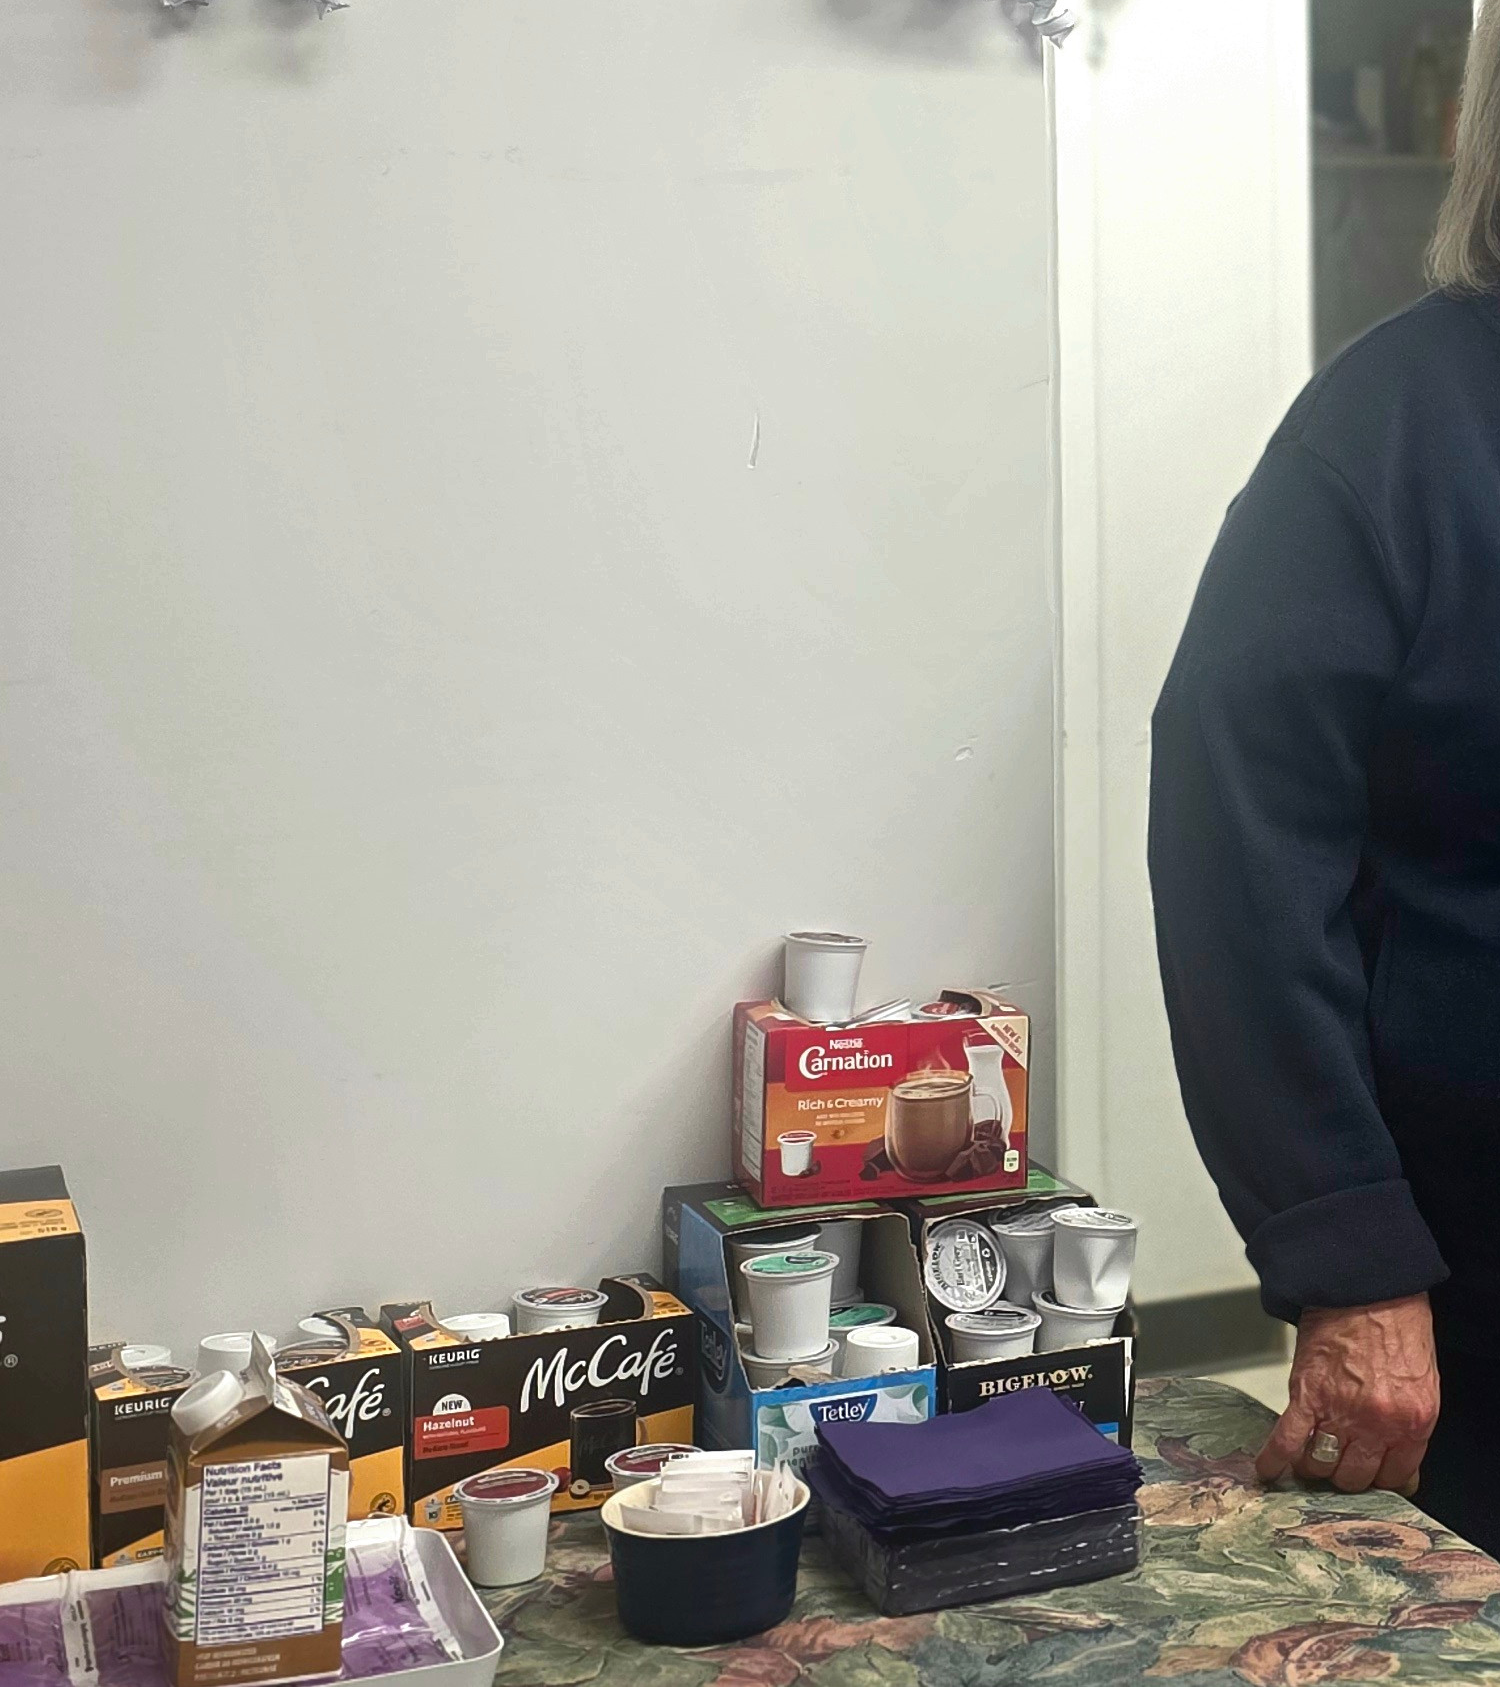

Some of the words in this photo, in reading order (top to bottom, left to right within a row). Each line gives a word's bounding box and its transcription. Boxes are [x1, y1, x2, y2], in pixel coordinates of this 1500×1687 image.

[799, 1046, 892, 1079] Carnation
[798, 1099, 824, 1111] Rich
[835, 1096, 884, 1109] Creamy
[429, 1348, 482, 1365] KEURIG
[520, 1328, 678, 1413] McCafé
[114, 1397, 172, 1416] KEURIG
[304, 1368, 385, 1439] afé
[441, 1400, 463, 1411] NEW
[818, 1399, 869, 1422] Tetley
[423, 1416, 475, 1432] Hazelnut
[110, 1471, 163, 1487] Premium
